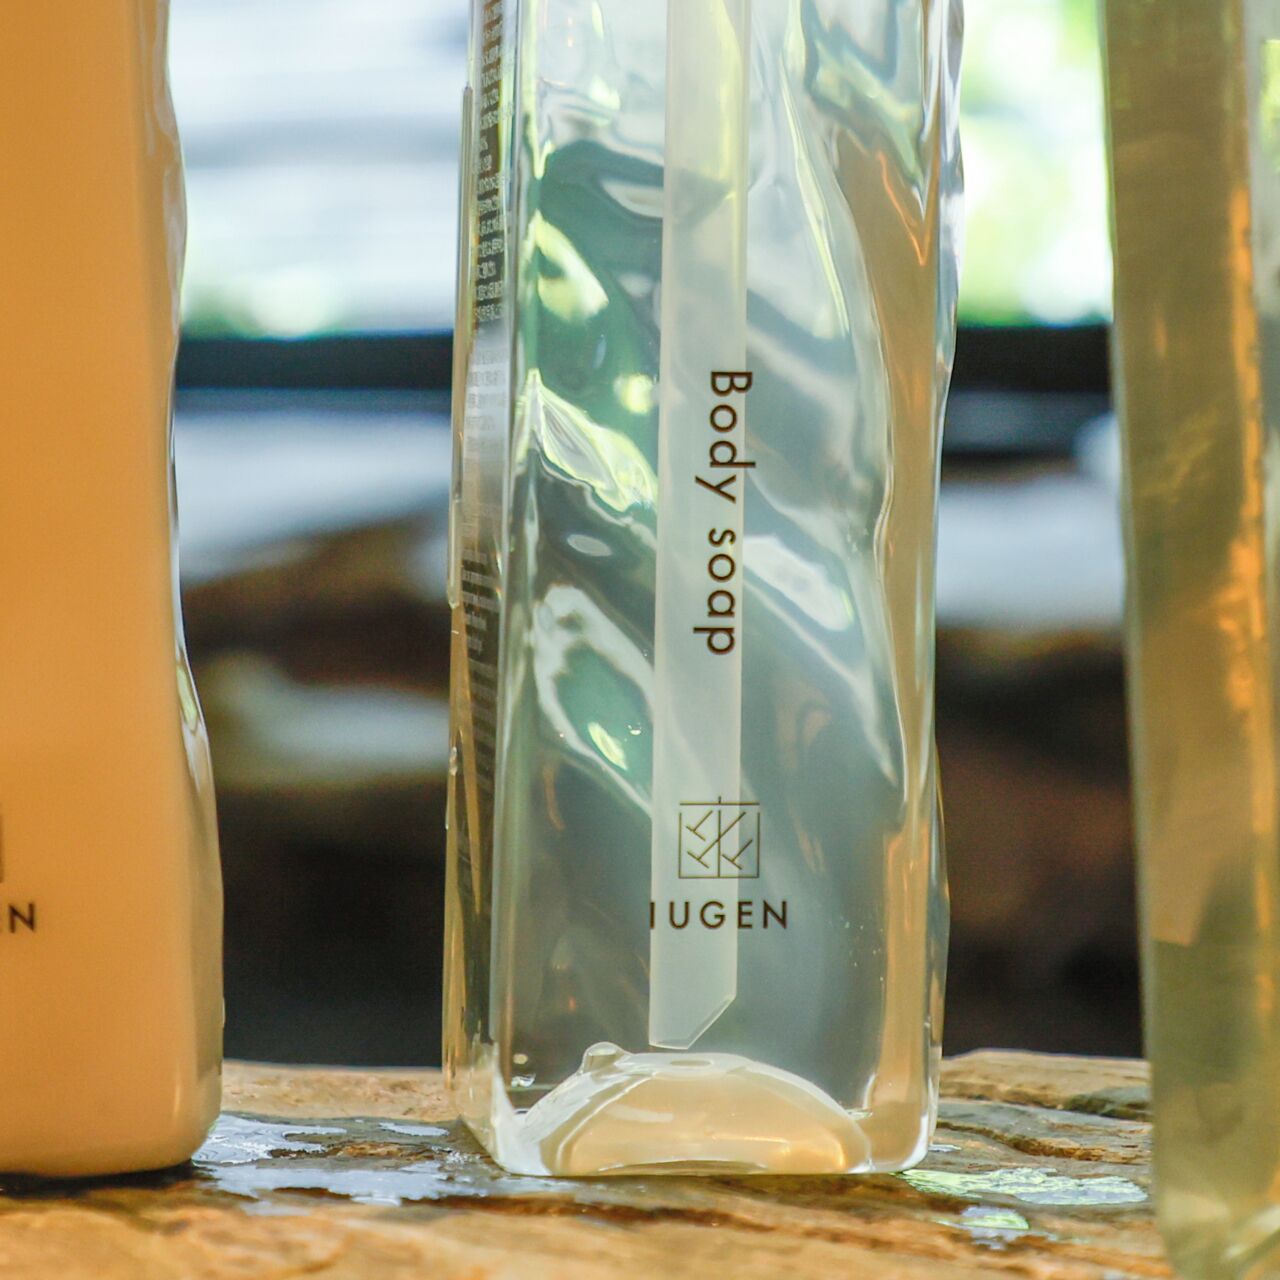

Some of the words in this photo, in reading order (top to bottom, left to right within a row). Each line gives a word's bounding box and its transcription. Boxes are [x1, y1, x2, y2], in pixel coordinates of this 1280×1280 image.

[696, 370, 756, 503] Body
[693, 528, 737, 656] soap
[649, 900, 789, 931] IUGEN
